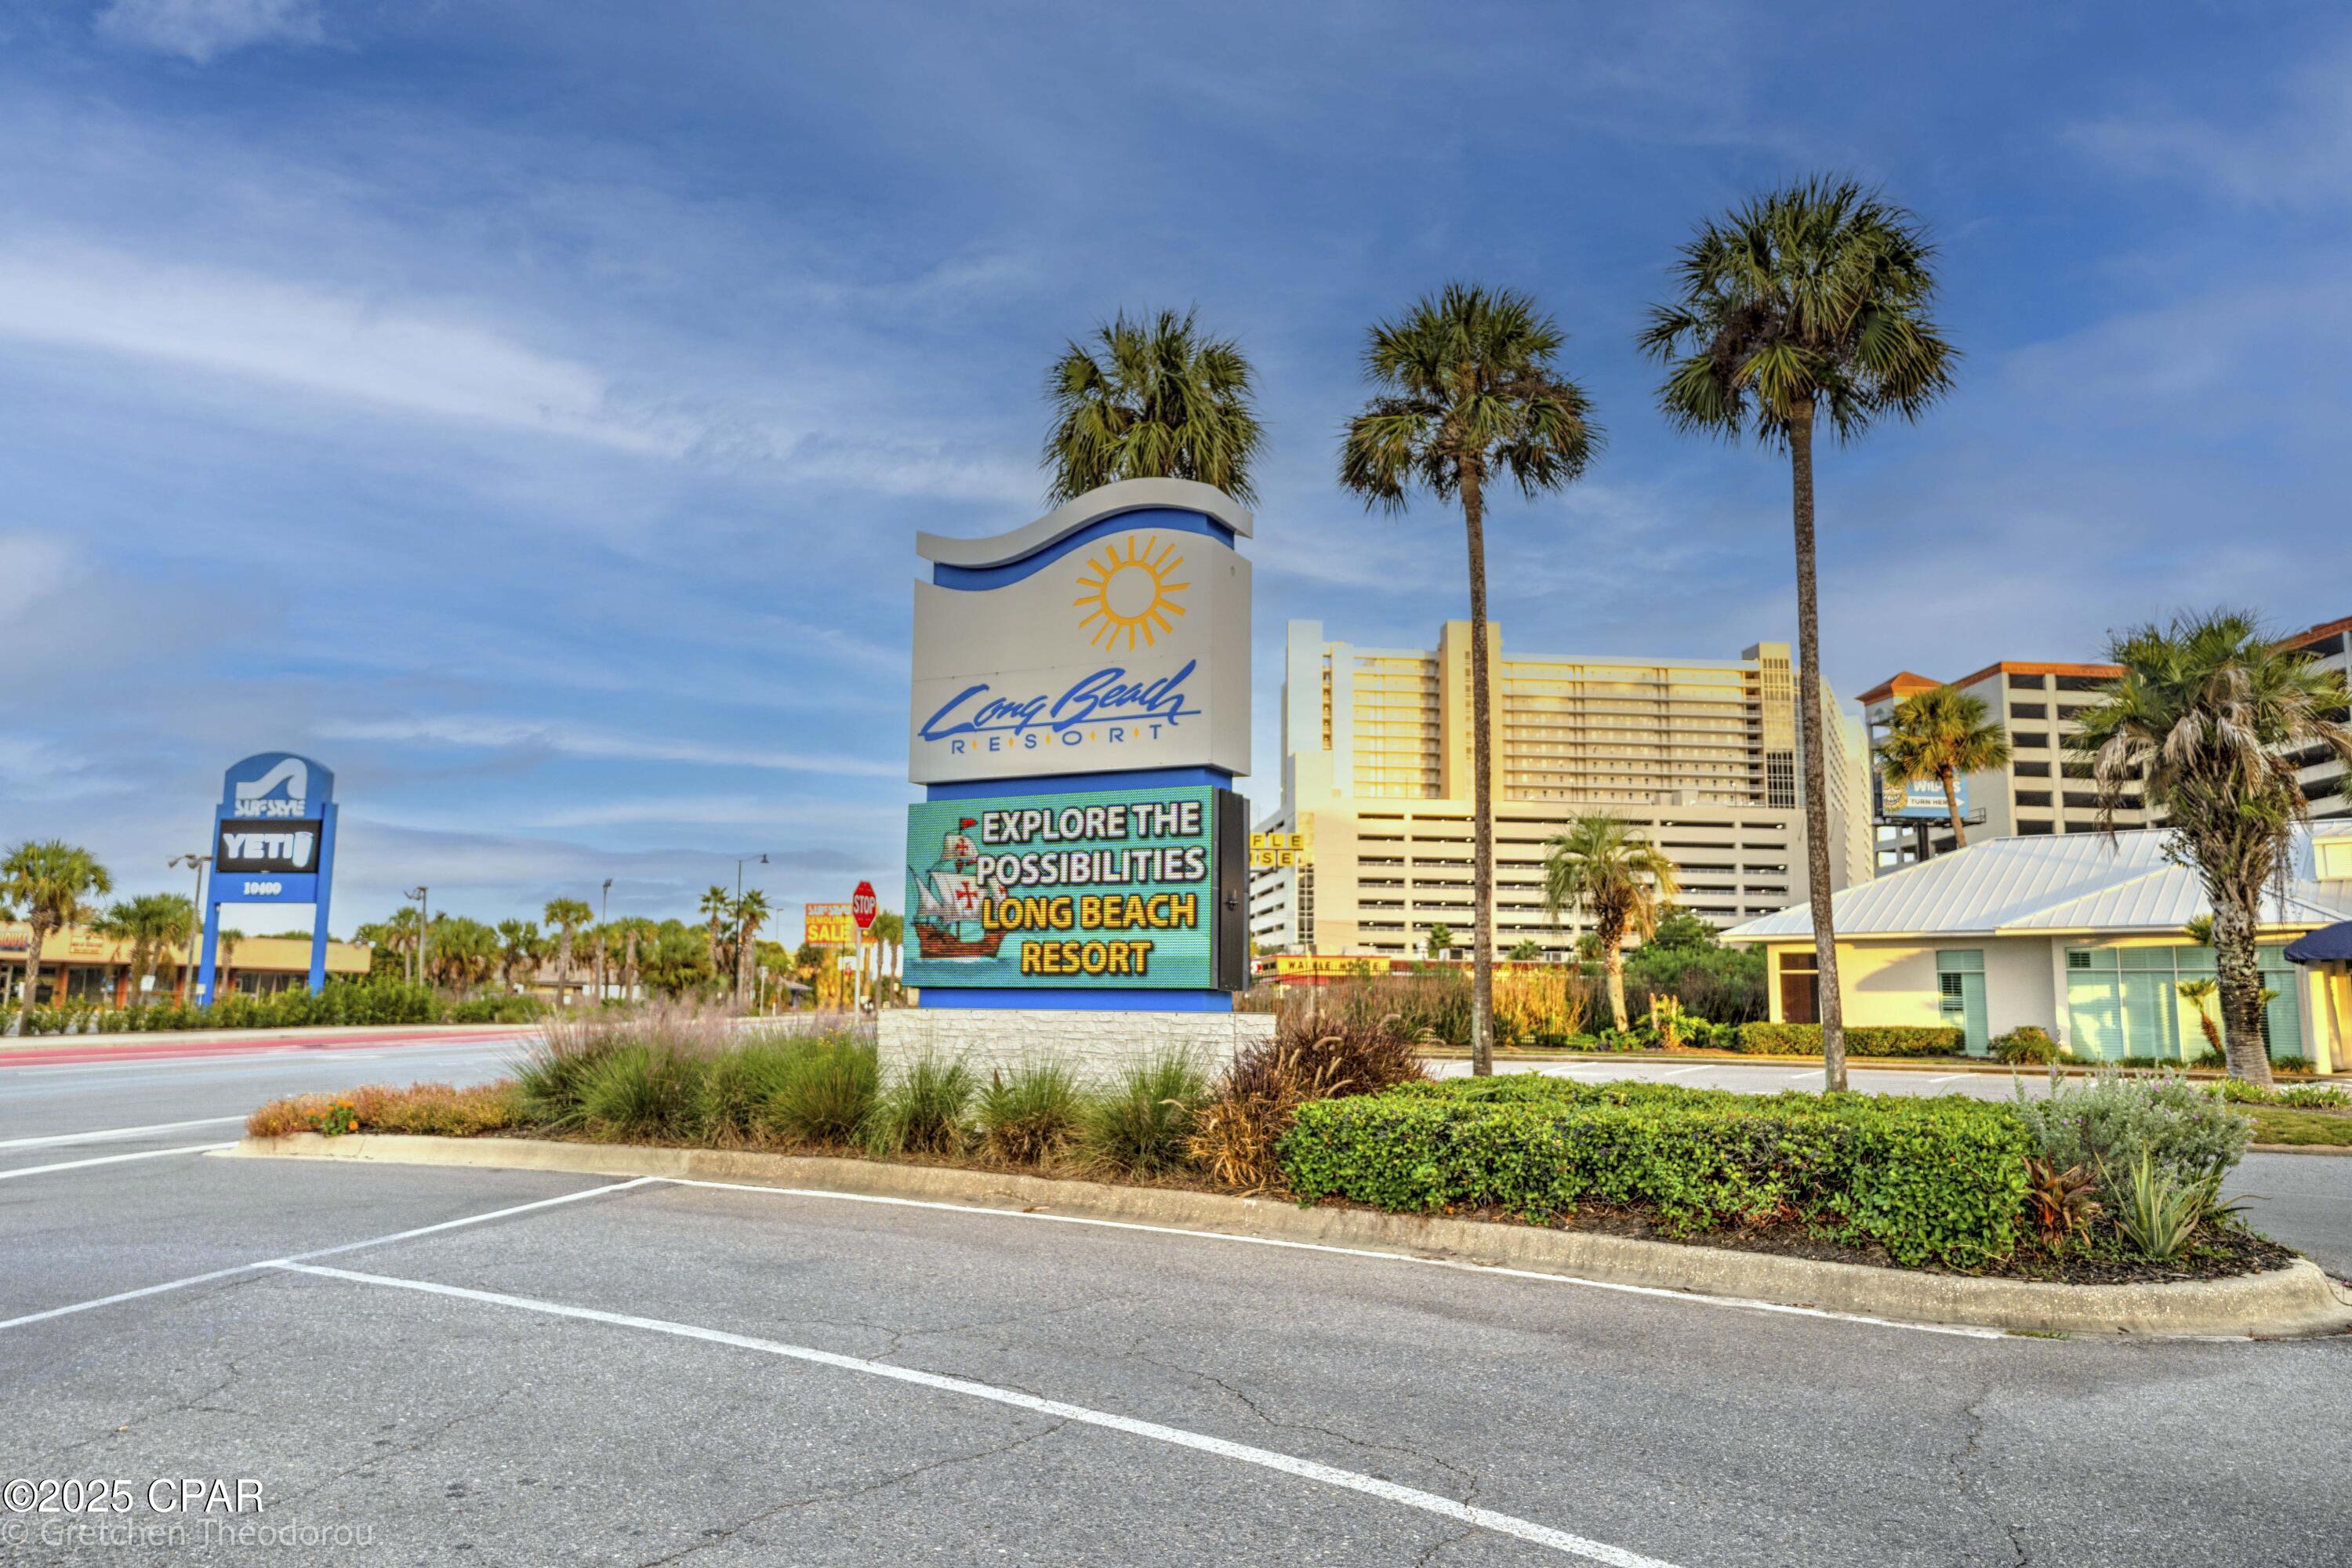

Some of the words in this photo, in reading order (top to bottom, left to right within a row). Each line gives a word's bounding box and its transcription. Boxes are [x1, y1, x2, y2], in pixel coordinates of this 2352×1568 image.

[917, 683, 1048, 742] Long
[1051, 659, 1196, 733] Beach
[951, 724, 1162, 755] RESORT
[982, 805, 1127, 844] EXPLORE
[1133, 801, 1202, 837] THE
[223, 833, 294, 858] YETI
[977, 847, 1207, 887] POSSIBILITIES
[854, 895, 876, 915] STOP
[982, 895, 1073, 931] LONG
[1080, 892, 1197, 929] BEACH
[808, 924, 851, 942] SALE
[1021, 940, 1154, 975] RESORT
